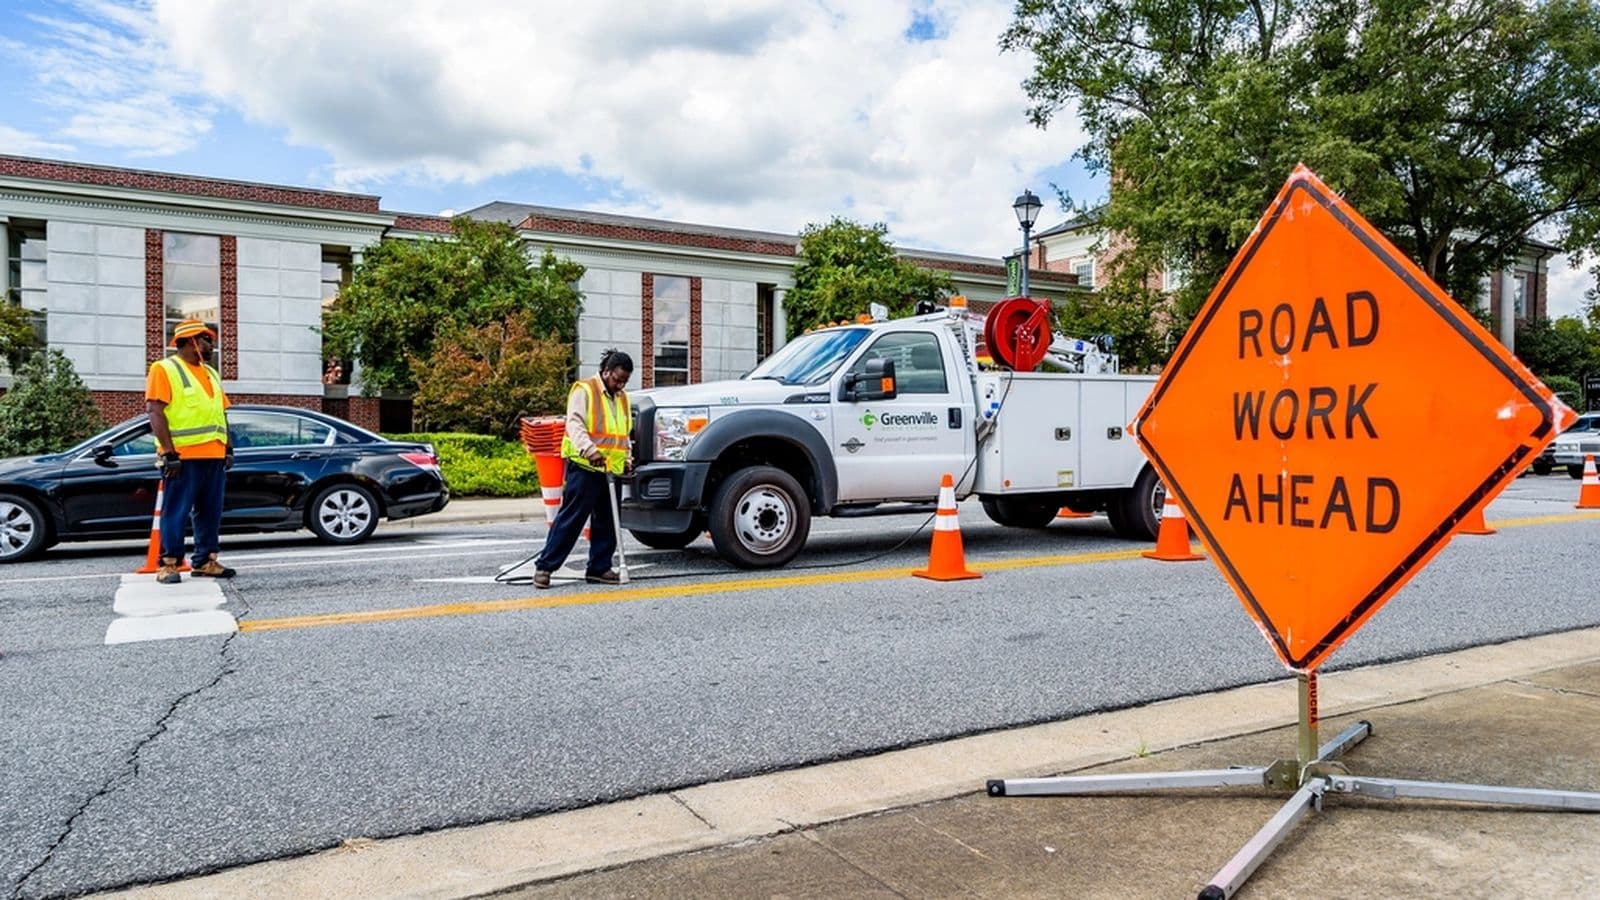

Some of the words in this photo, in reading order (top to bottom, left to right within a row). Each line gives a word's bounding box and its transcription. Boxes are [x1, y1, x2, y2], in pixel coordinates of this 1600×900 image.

[1239, 290, 1380, 359] ROAD
[880, 411, 938, 426] Greenville
[1233, 383, 1380, 441] WORK
[1223, 473, 1401, 534] AHEAD
